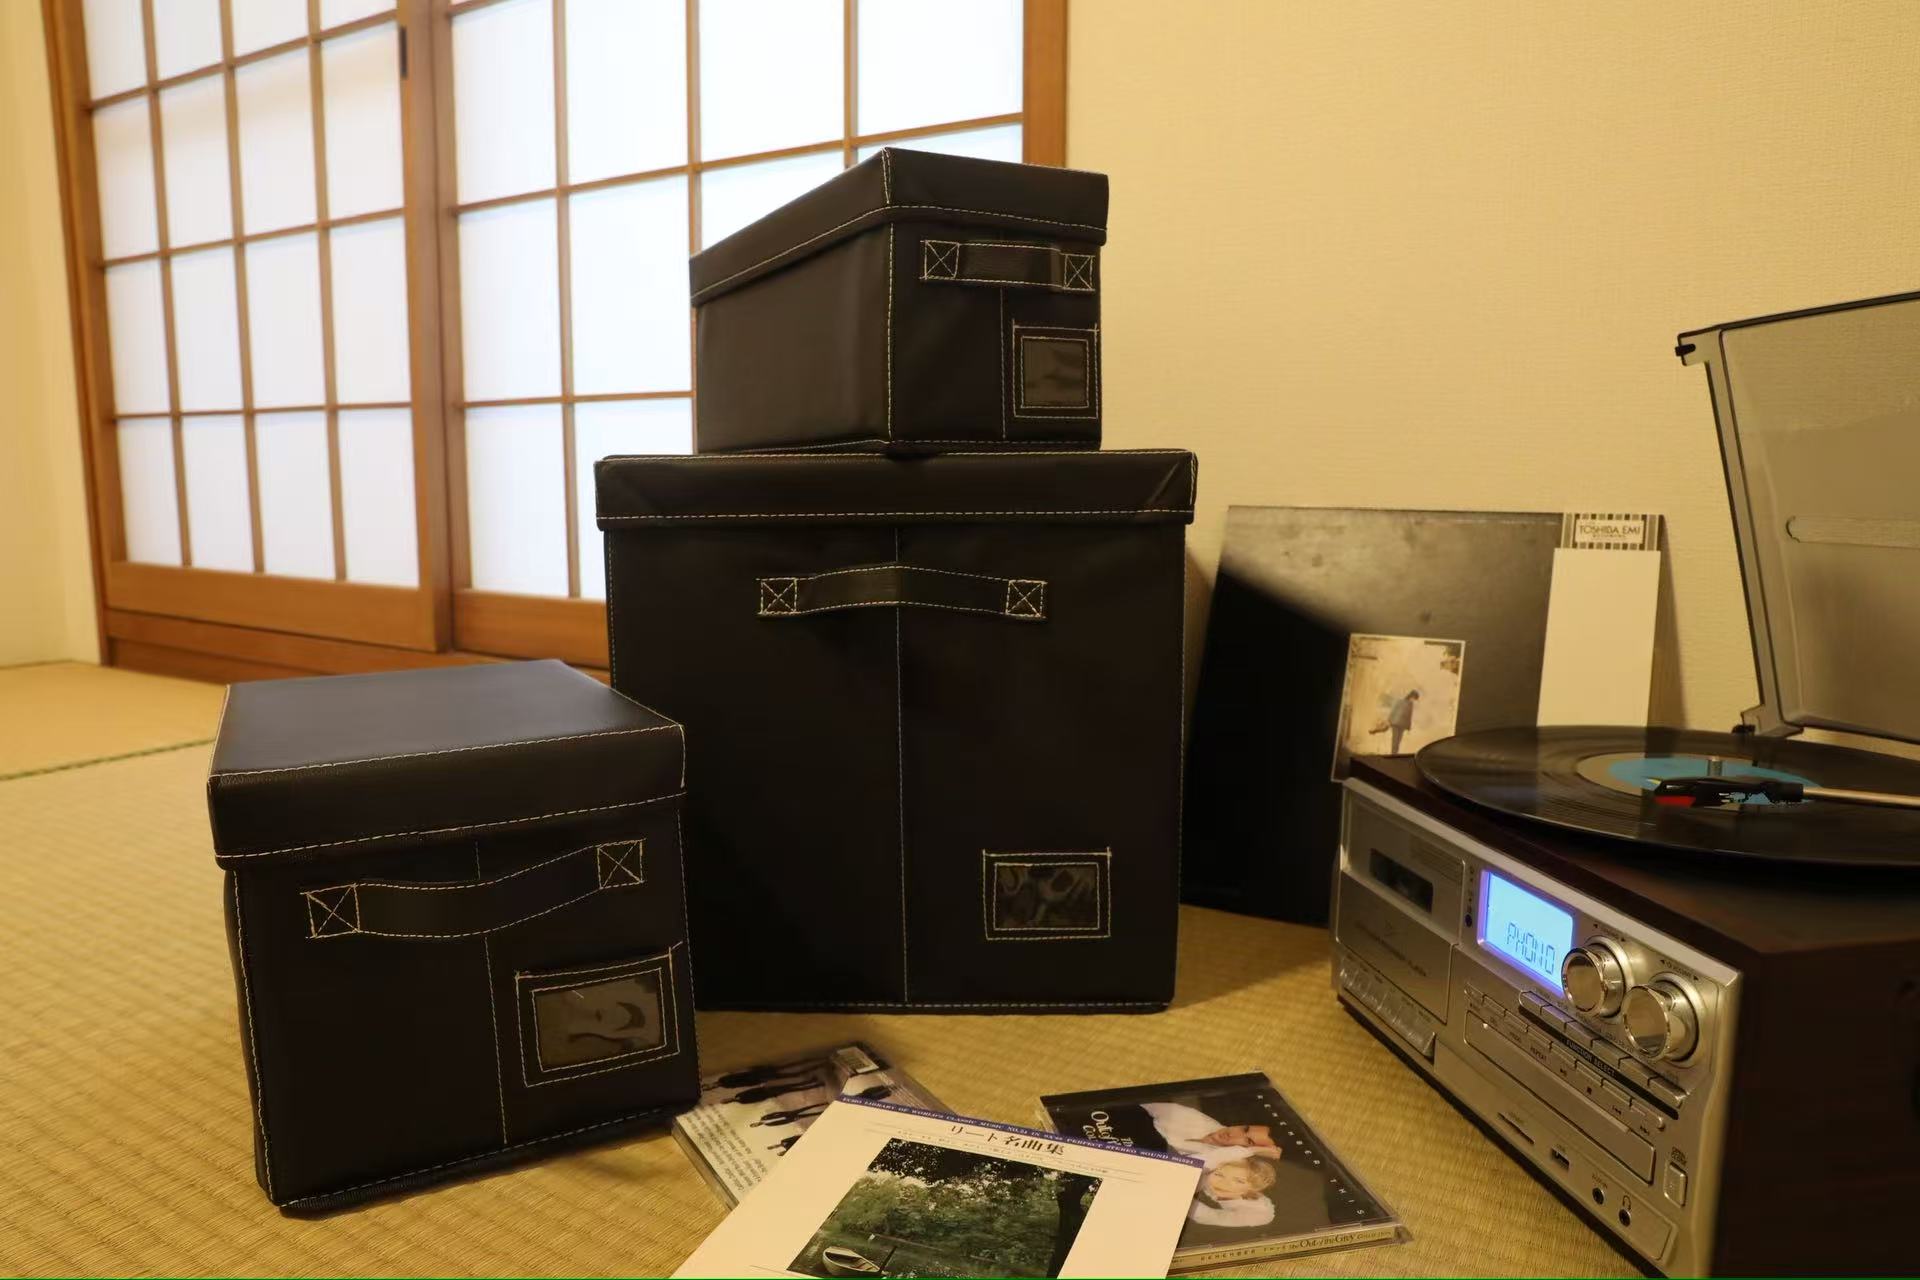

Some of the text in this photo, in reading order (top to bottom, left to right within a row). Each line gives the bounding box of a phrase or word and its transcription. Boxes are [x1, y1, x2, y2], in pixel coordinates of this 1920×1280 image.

[1622, 525, 1640, 535] EMI
[1506, 922, 1556, 975] PHONO
[1566, 1040, 1594, 1065] FUNCTION
[1594, 1056, 1616, 1078] SELECT
[864, 1100, 895, 1110] LIBRARY
[979, 1121, 1004, 1129] MUSIC
[1066, 1138, 1103, 1148] PERFECT
[1105, 1144, 1137, 1154] STEREO
[1140, 1150, 1169, 1159] SOUND
[1091, 1111, 1114, 1132] Out
[951, 1125, 1065, 1156] リート名曲集
[1257, 1095, 1364, 1214] REMEMBER THIS
[1300, 1239, 1316, 1249] Out
